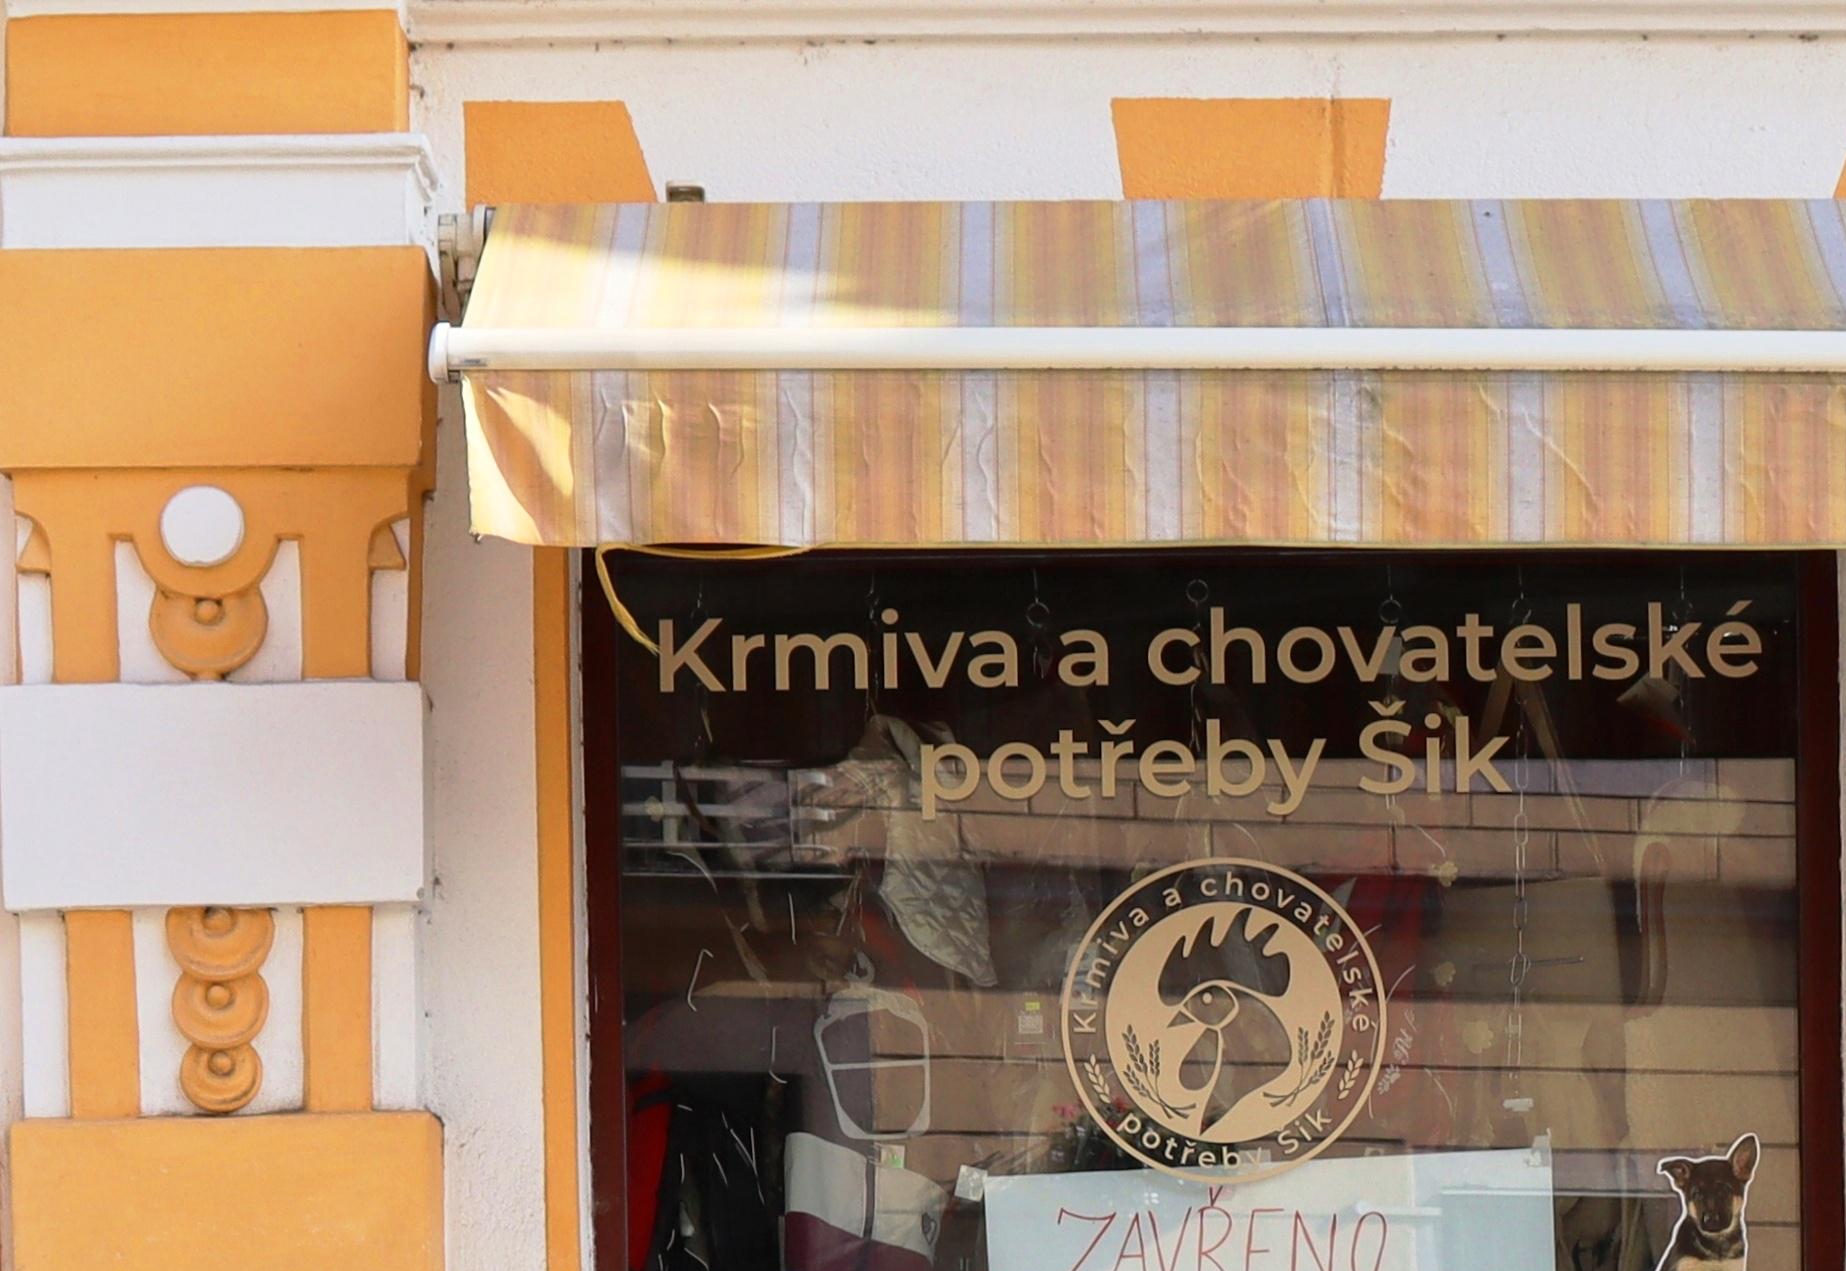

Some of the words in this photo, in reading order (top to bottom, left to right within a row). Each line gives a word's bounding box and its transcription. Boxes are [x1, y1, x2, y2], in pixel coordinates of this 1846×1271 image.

[659, 609, 1018, 692] Krmiva
[1059, 633, 1111, 686] a
[1147, 599, 1763, 683] chovatelské
[922, 716, 1328, 821] potřeby
[1359, 701, 1514, 795] Šik
[1074, 906, 1150, 1033] Krmiva
[1162, 888, 1182, 907] a
[1201, 872, 1377, 1033] chovatelské
[1117, 1113, 1261, 1169] potřeby
[1274, 1107, 1332, 1154] Šik
